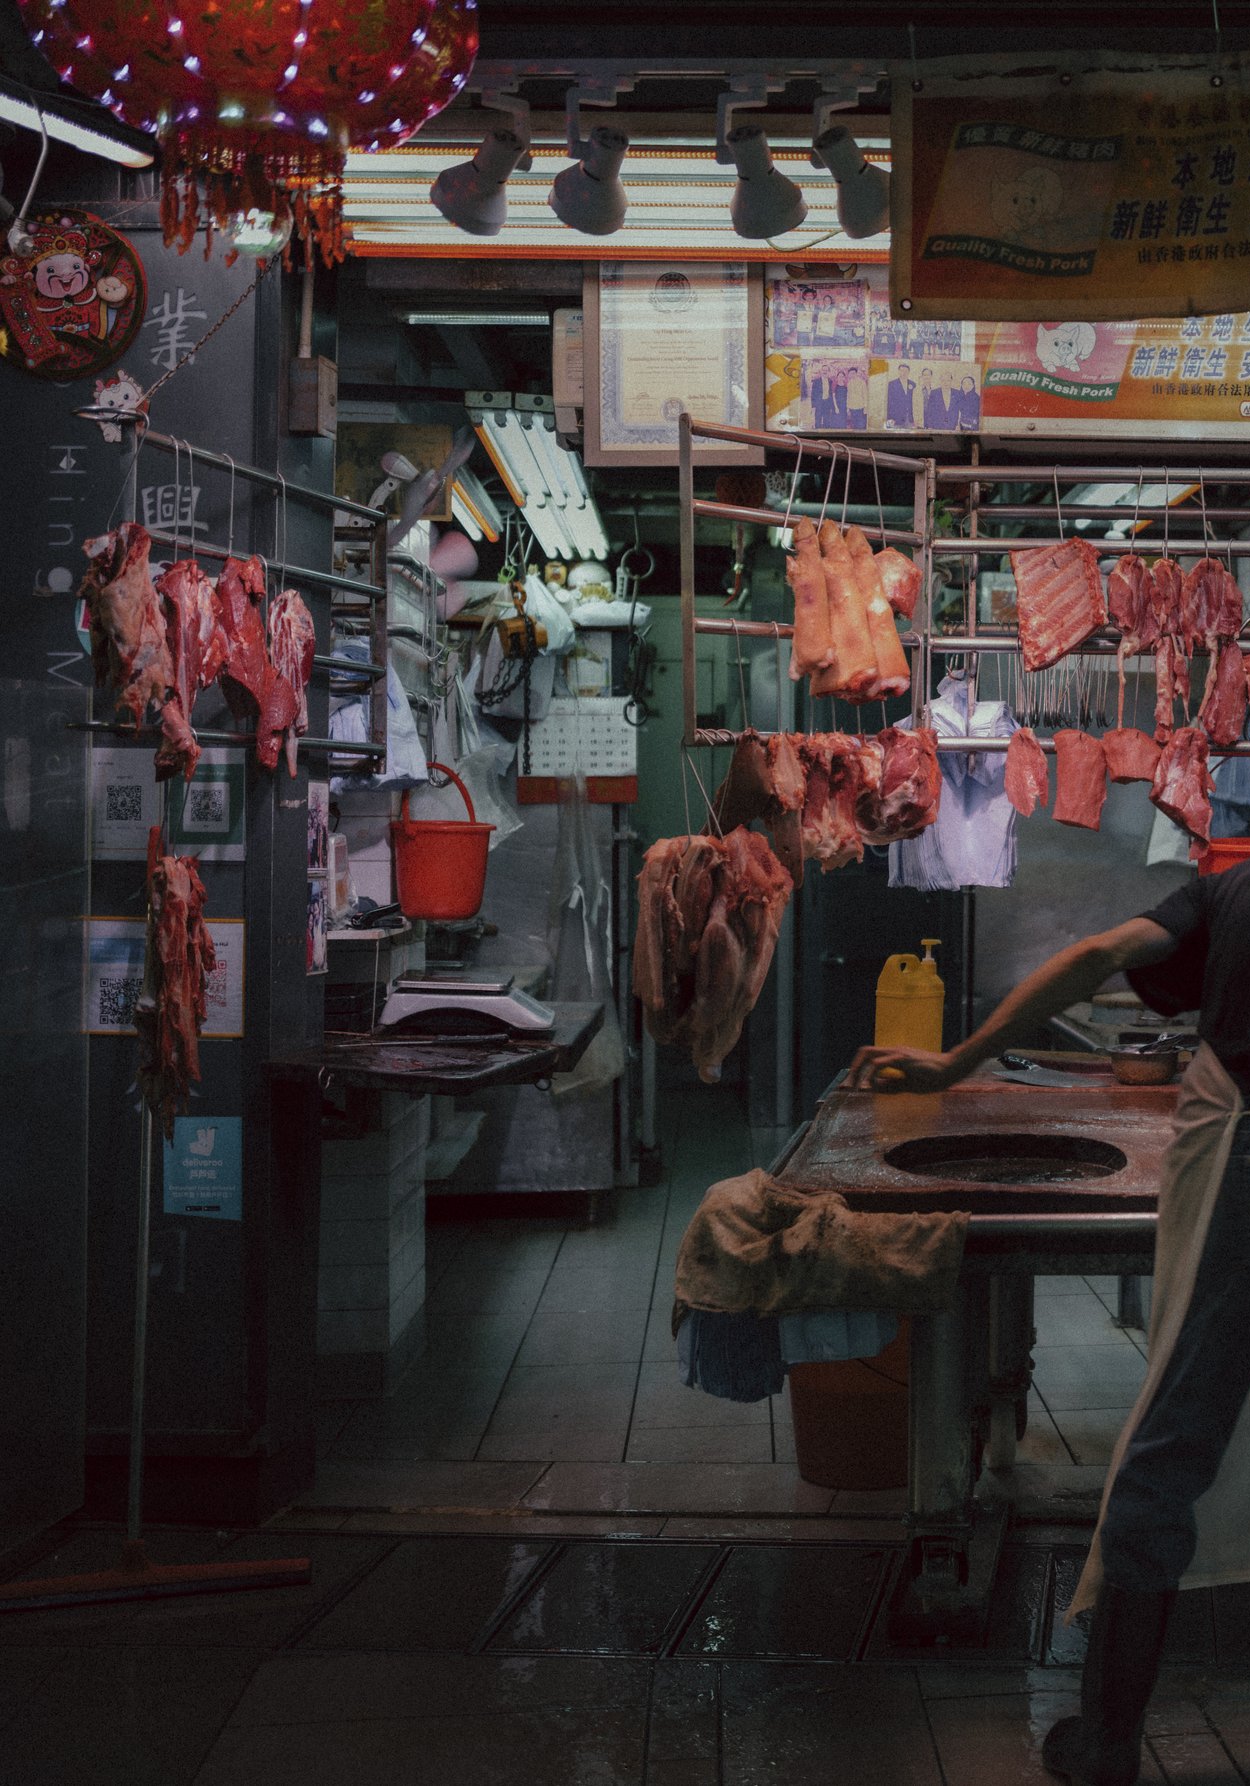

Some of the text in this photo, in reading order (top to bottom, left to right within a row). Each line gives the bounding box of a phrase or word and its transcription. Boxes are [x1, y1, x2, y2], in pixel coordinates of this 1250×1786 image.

[931, 240, 1090, 271] Quality Fresh Pork
[988, 372, 1114, 397] Quality Fresh Pork
[182, 1158, 223, 1168] deliveroo
